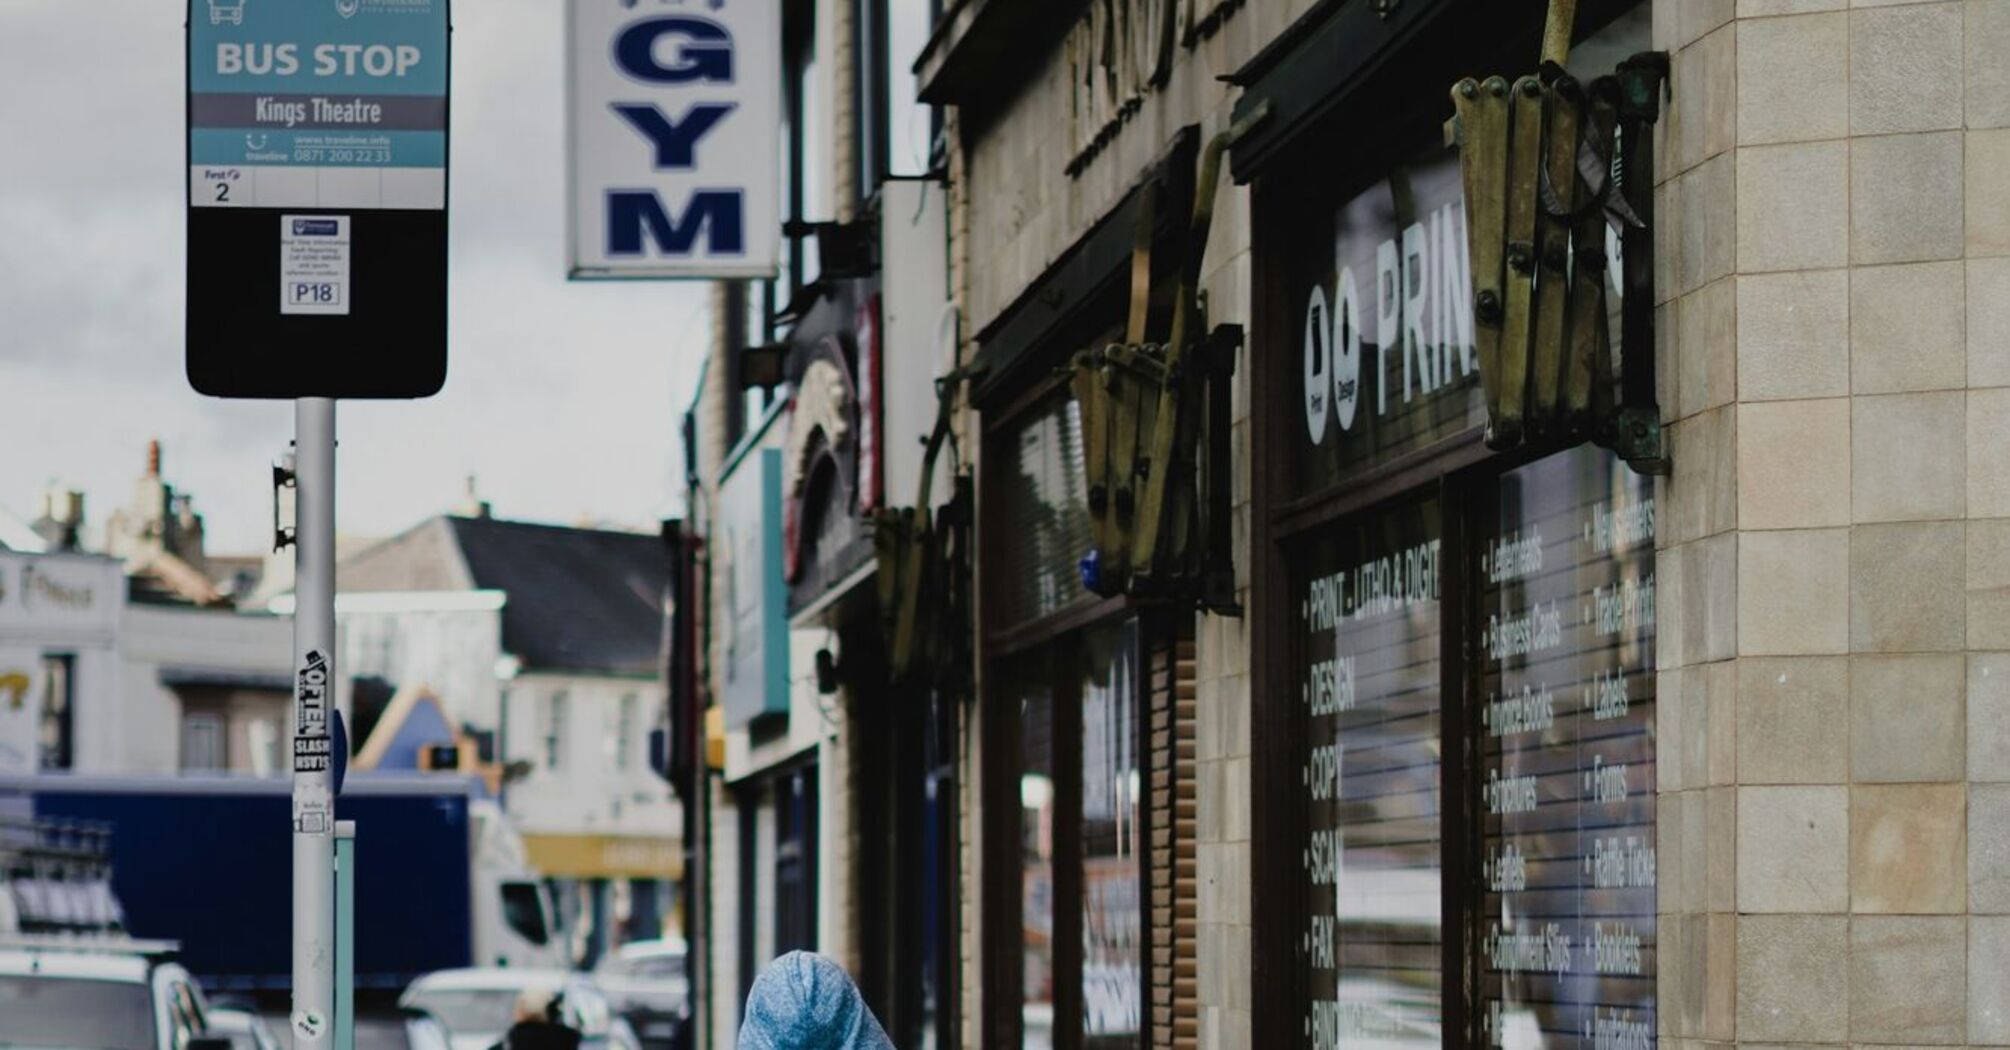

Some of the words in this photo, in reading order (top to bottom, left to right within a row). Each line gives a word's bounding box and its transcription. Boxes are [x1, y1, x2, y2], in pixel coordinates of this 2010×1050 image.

[216, 43, 300, 75] BUS
[313, 44, 421, 77] STOP
[255, 97, 306, 127] Kings
[311, 98, 382, 123] Theatre
[603, 14, 746, 260] GYM
[246, 151, 289, 162] traveline
[294, 135, 391, 146] www.traveline.info
[294, 149, 325, 162] 0871
[329, 150, 353, 162] 200
[356, 151, 372, 162] 22
[375, 150, 391, 163] 33
[205, 169, 227, 180] First
[215, 183, 230, 202] 2
[296, 283, 333, 302] P18
[1377, 196, 1480, 416] PRIN
[1490, 523, 1543, 584] Letterheads
[1310, 571, 1345, 633] PRINT
[1354, 556, 1392, 622] LITHO
[1392, 552, 1404, 610] &
[1594, 581, 1623, 637] Trade
[1490, 611, 1531, 661] Business
[1533, 598, 1561, 650] Cards
[305, 667, 327, 737] OFTEN
[1310, 656, 1356, 717] DESIGN
[1490, 688, 1522, 737] Invoice
[1523, 681, 1553, 732] Books
[1594, 666, 1628, 721] Labels
[295, 739, 330, 753] SLASH
[1310, 745, 1344, 801] COPY
[1490, 767, 1537, 814] Brochures
[1594, 754, 1628, 804] Forms
[1310, 829, 1344, 885] SCAN
[1491, 844, 1526, 892] Leaflets
[1594, 838, 1625, 889] Raffle
[1311, 915, 1335, 969] FAX
[1491, 922, 1545, 982] Compliment
[1546, 922, 1571, 984] Slips
[1594, 921, 1641, 975] Booklets
[1594, 1005, 1650, 1050] Invitations
